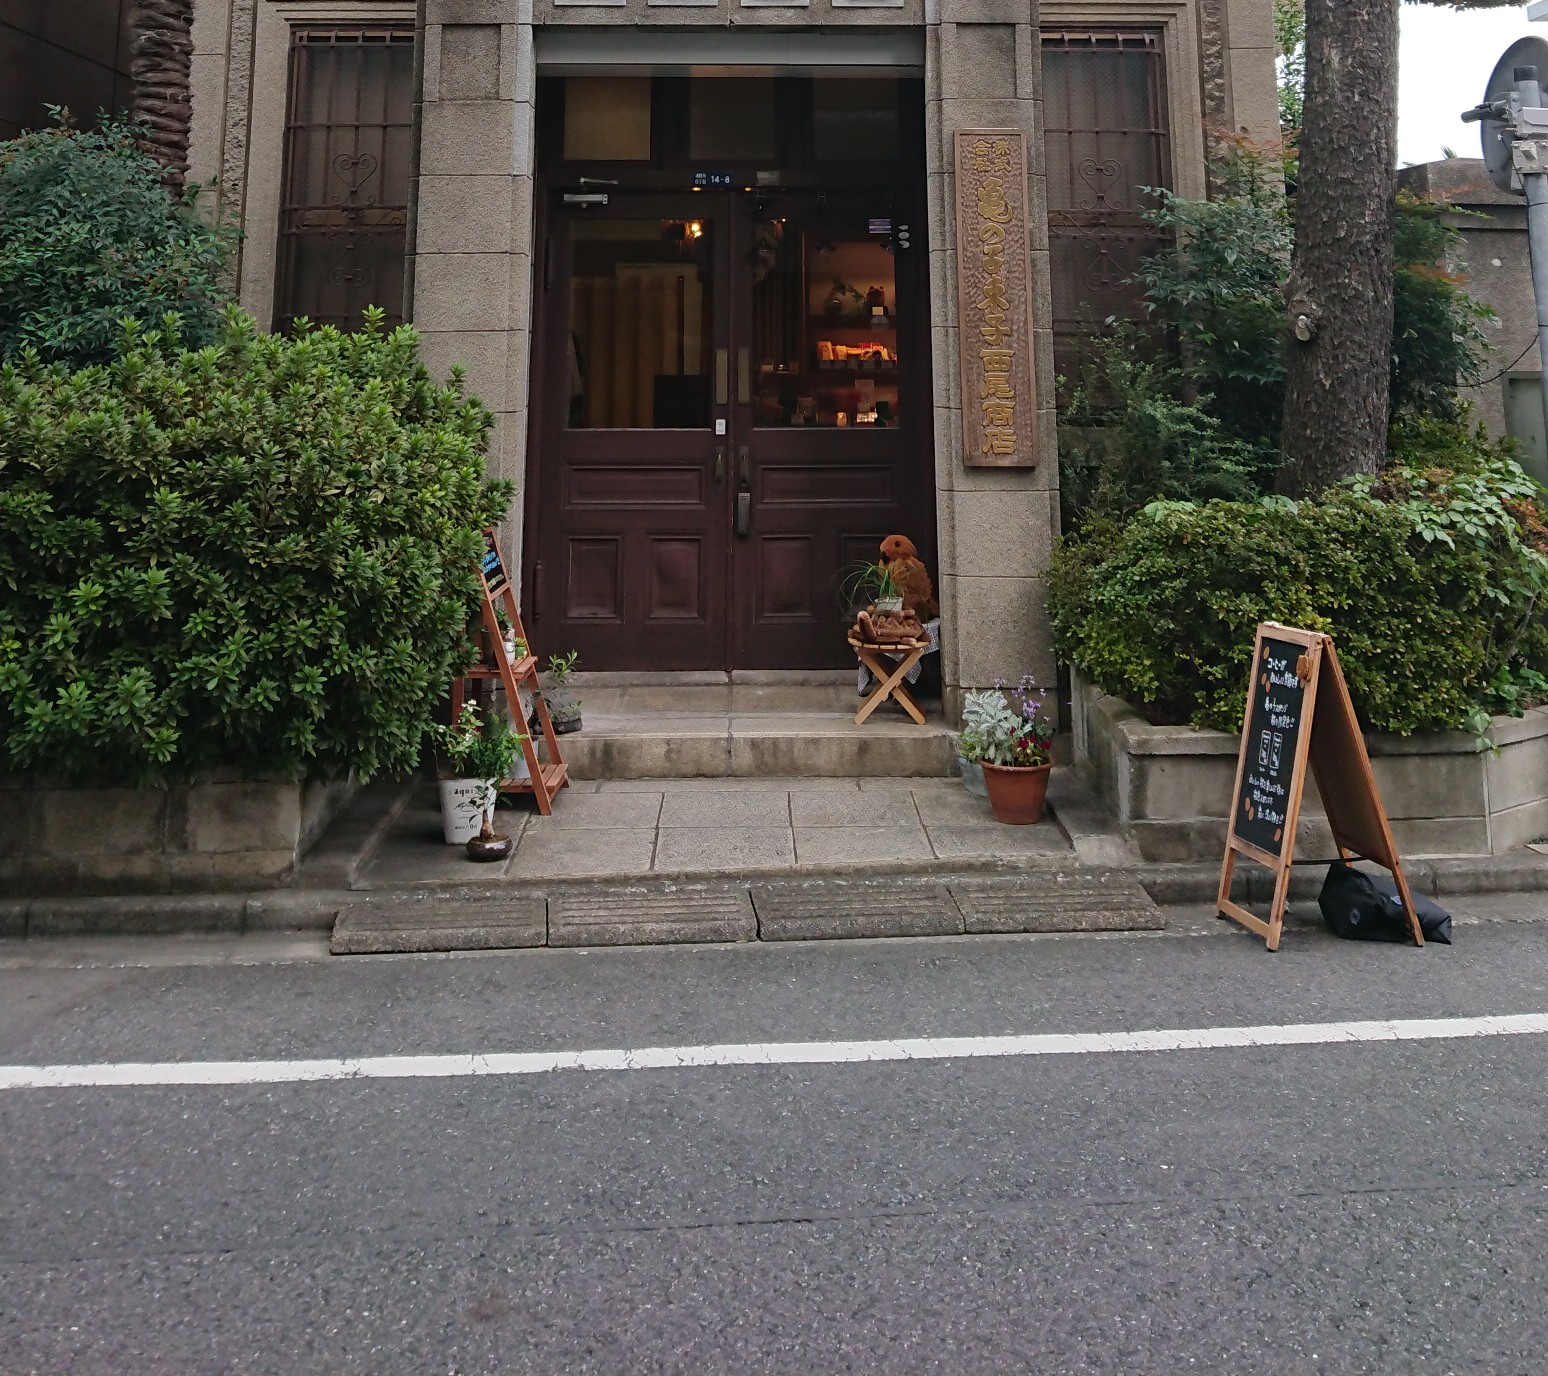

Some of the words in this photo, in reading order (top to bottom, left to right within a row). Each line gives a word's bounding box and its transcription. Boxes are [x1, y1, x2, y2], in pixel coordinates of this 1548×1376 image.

[710, 175, 730, 184] 14-8
[976, 176, 1018, 455] 亀の子束子西尾商店
